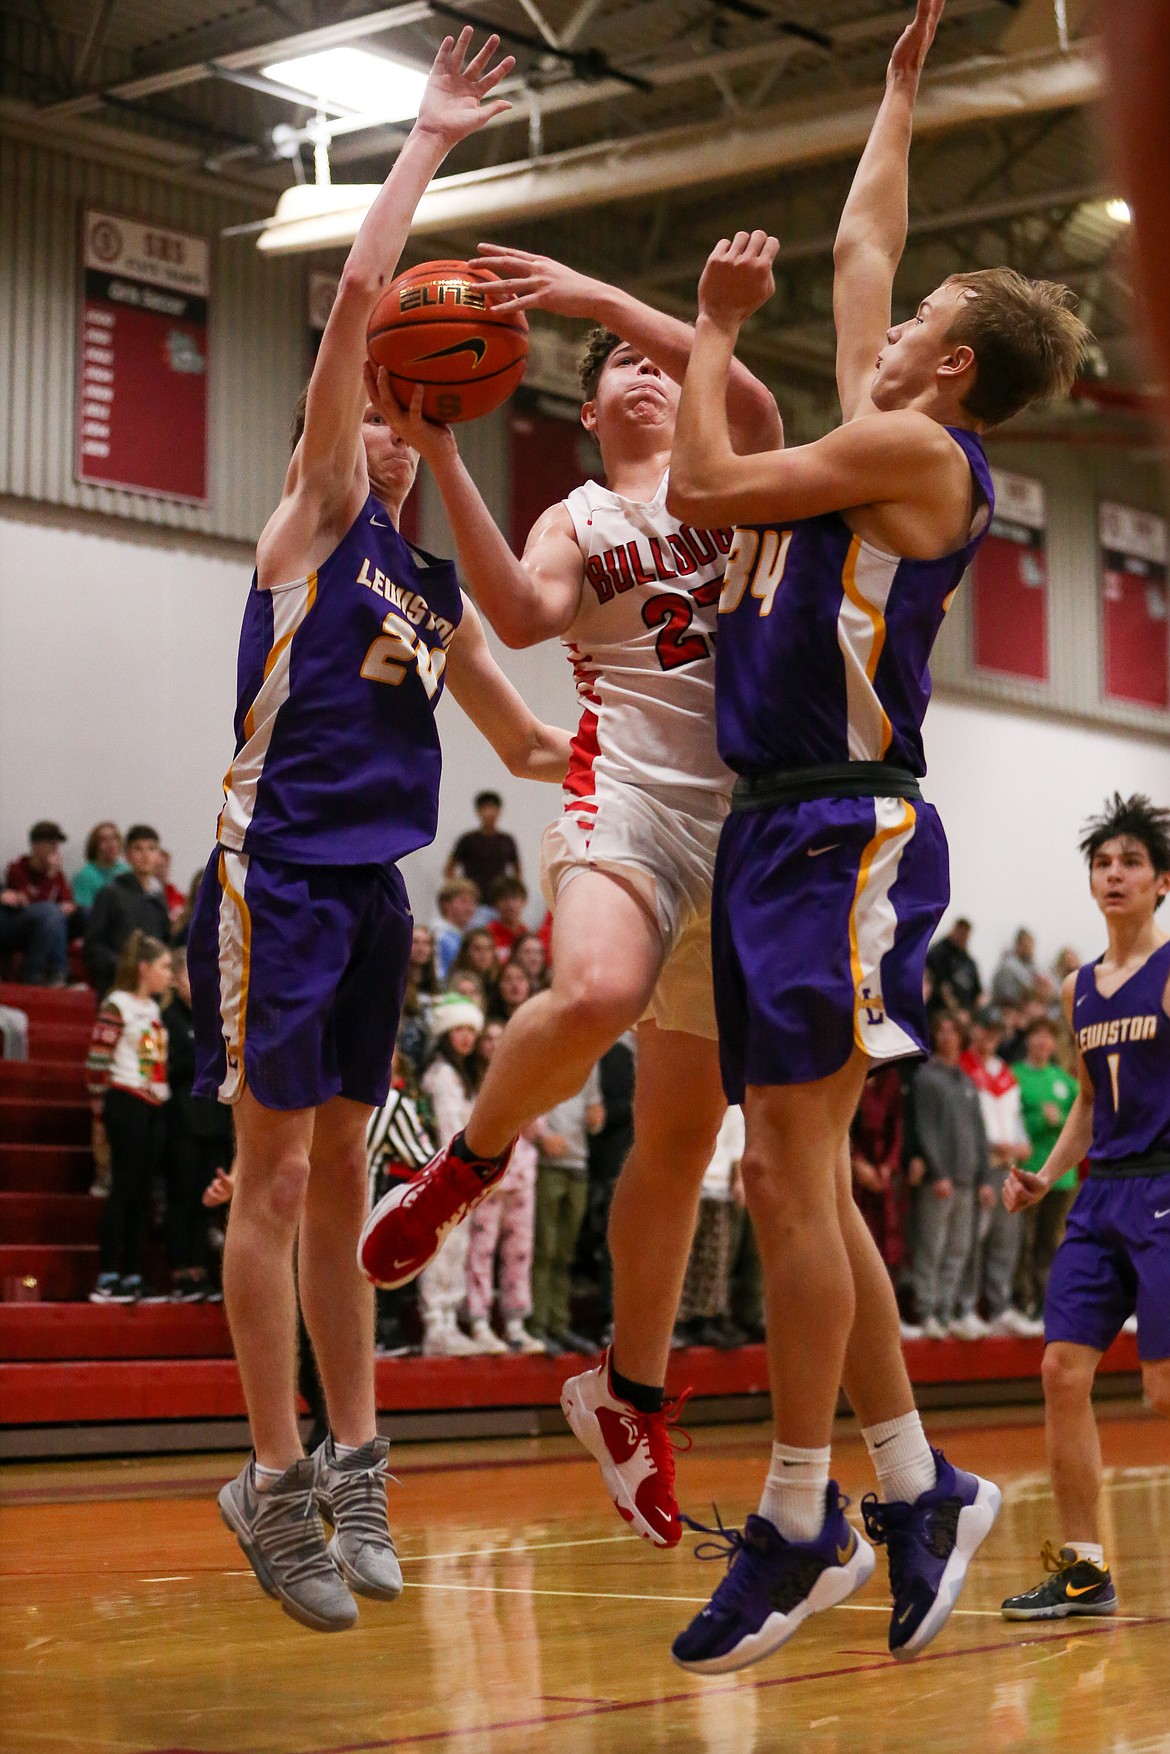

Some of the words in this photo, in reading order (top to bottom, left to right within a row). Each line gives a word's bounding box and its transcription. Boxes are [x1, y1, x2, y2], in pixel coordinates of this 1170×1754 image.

[400, 285, 486, 314] ELITE
[718, 528, 793, 617] 34
[360, 611, 447, 700] 24
[641, 572, 727, 671] 2
[1076, 1015, 1157, 1053] EWISTON
[1106, 1053, 1120, 1114] 1
